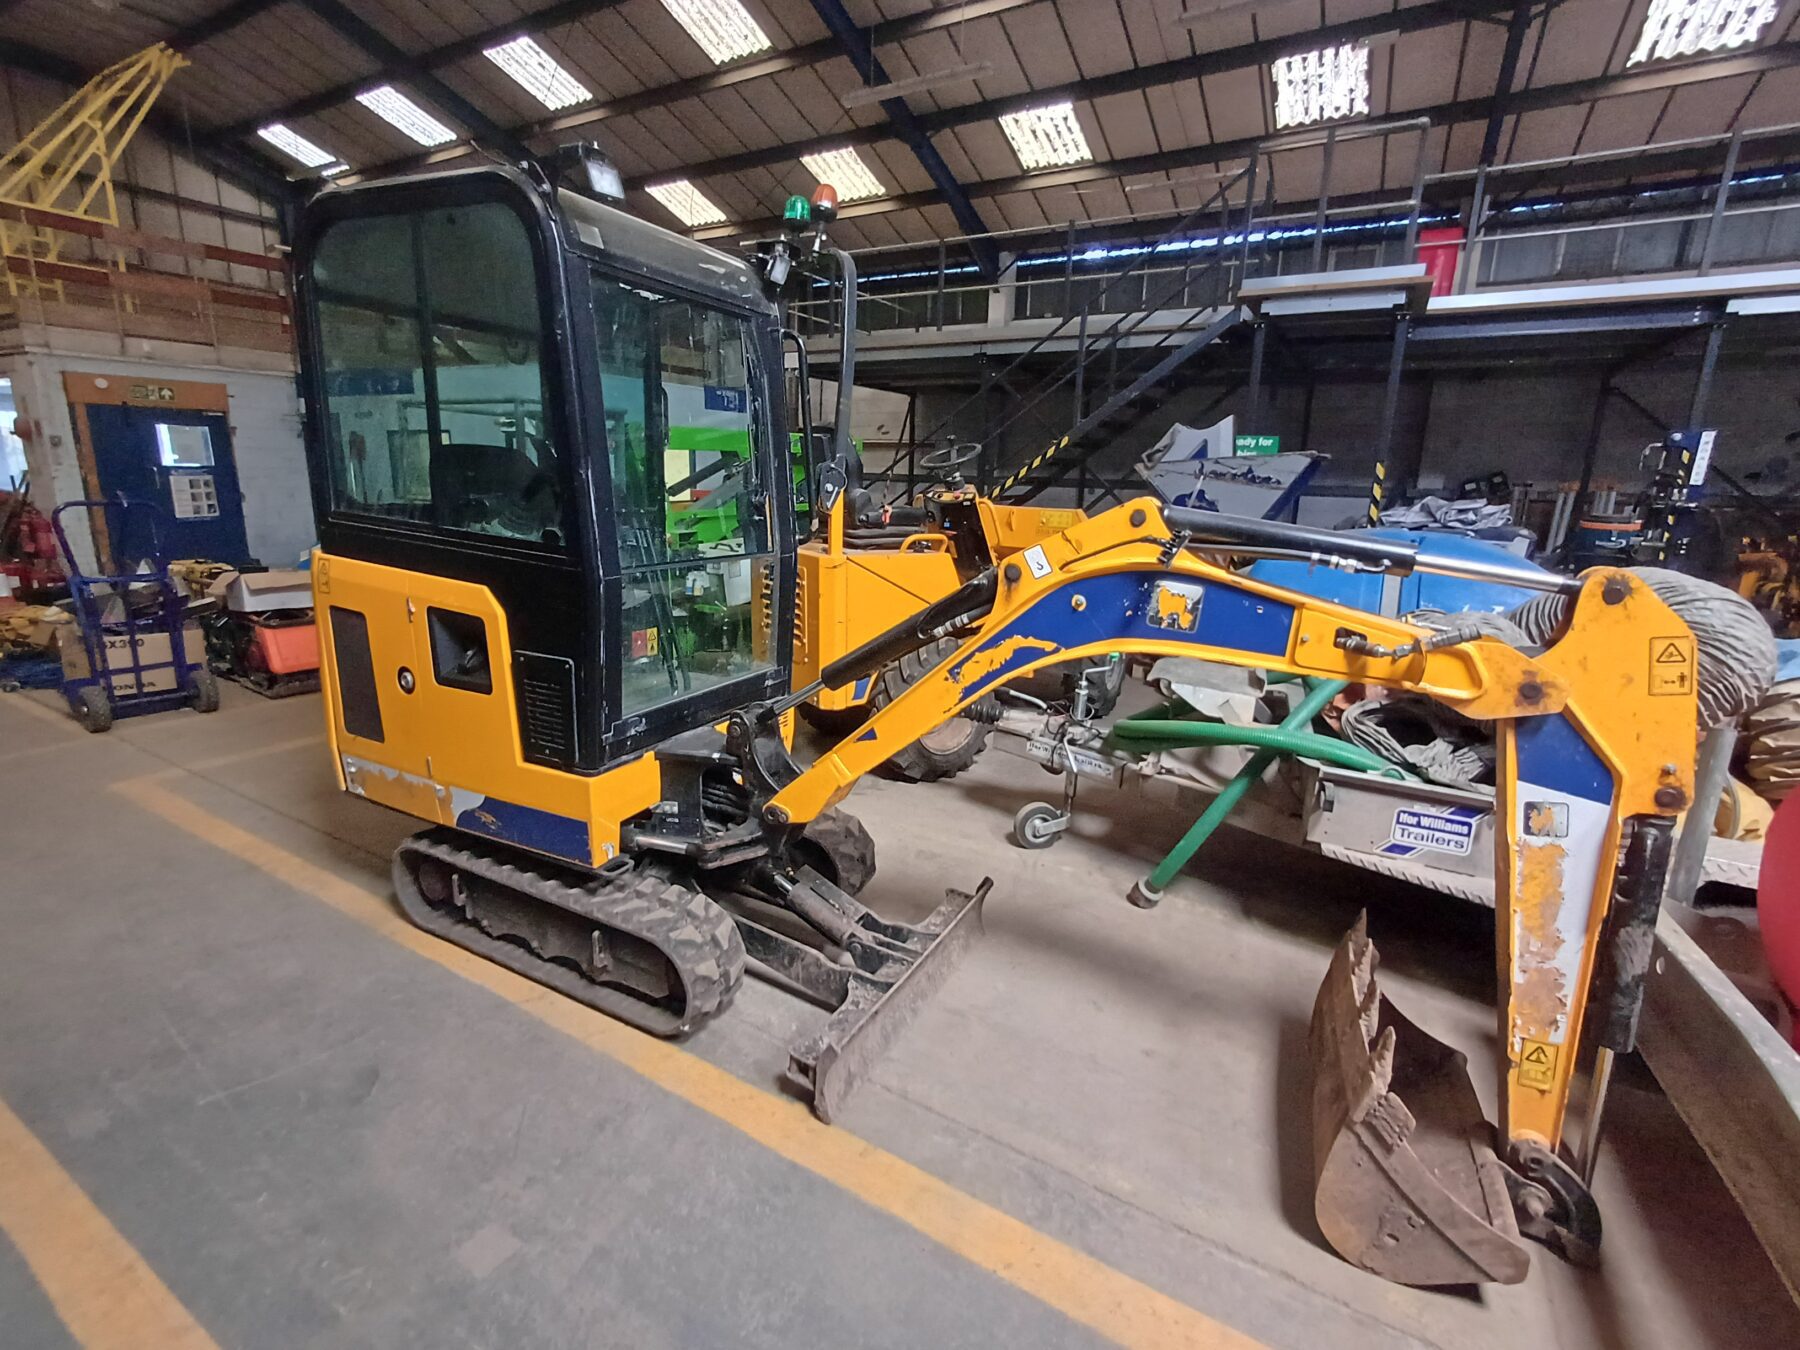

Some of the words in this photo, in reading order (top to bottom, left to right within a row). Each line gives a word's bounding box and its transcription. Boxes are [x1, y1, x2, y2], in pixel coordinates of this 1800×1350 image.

[1236, 437, 1257, 448] ady
[1258, 437, 1273, 447] for
[104, 638, 145, 650] X30
[102, 681, 156, 692] ONA
[1399, 812, 1419, 826] Ifor
[1420, 815, 1470, 836] Williams
[1398, 826, 1465, 850] Trailers
